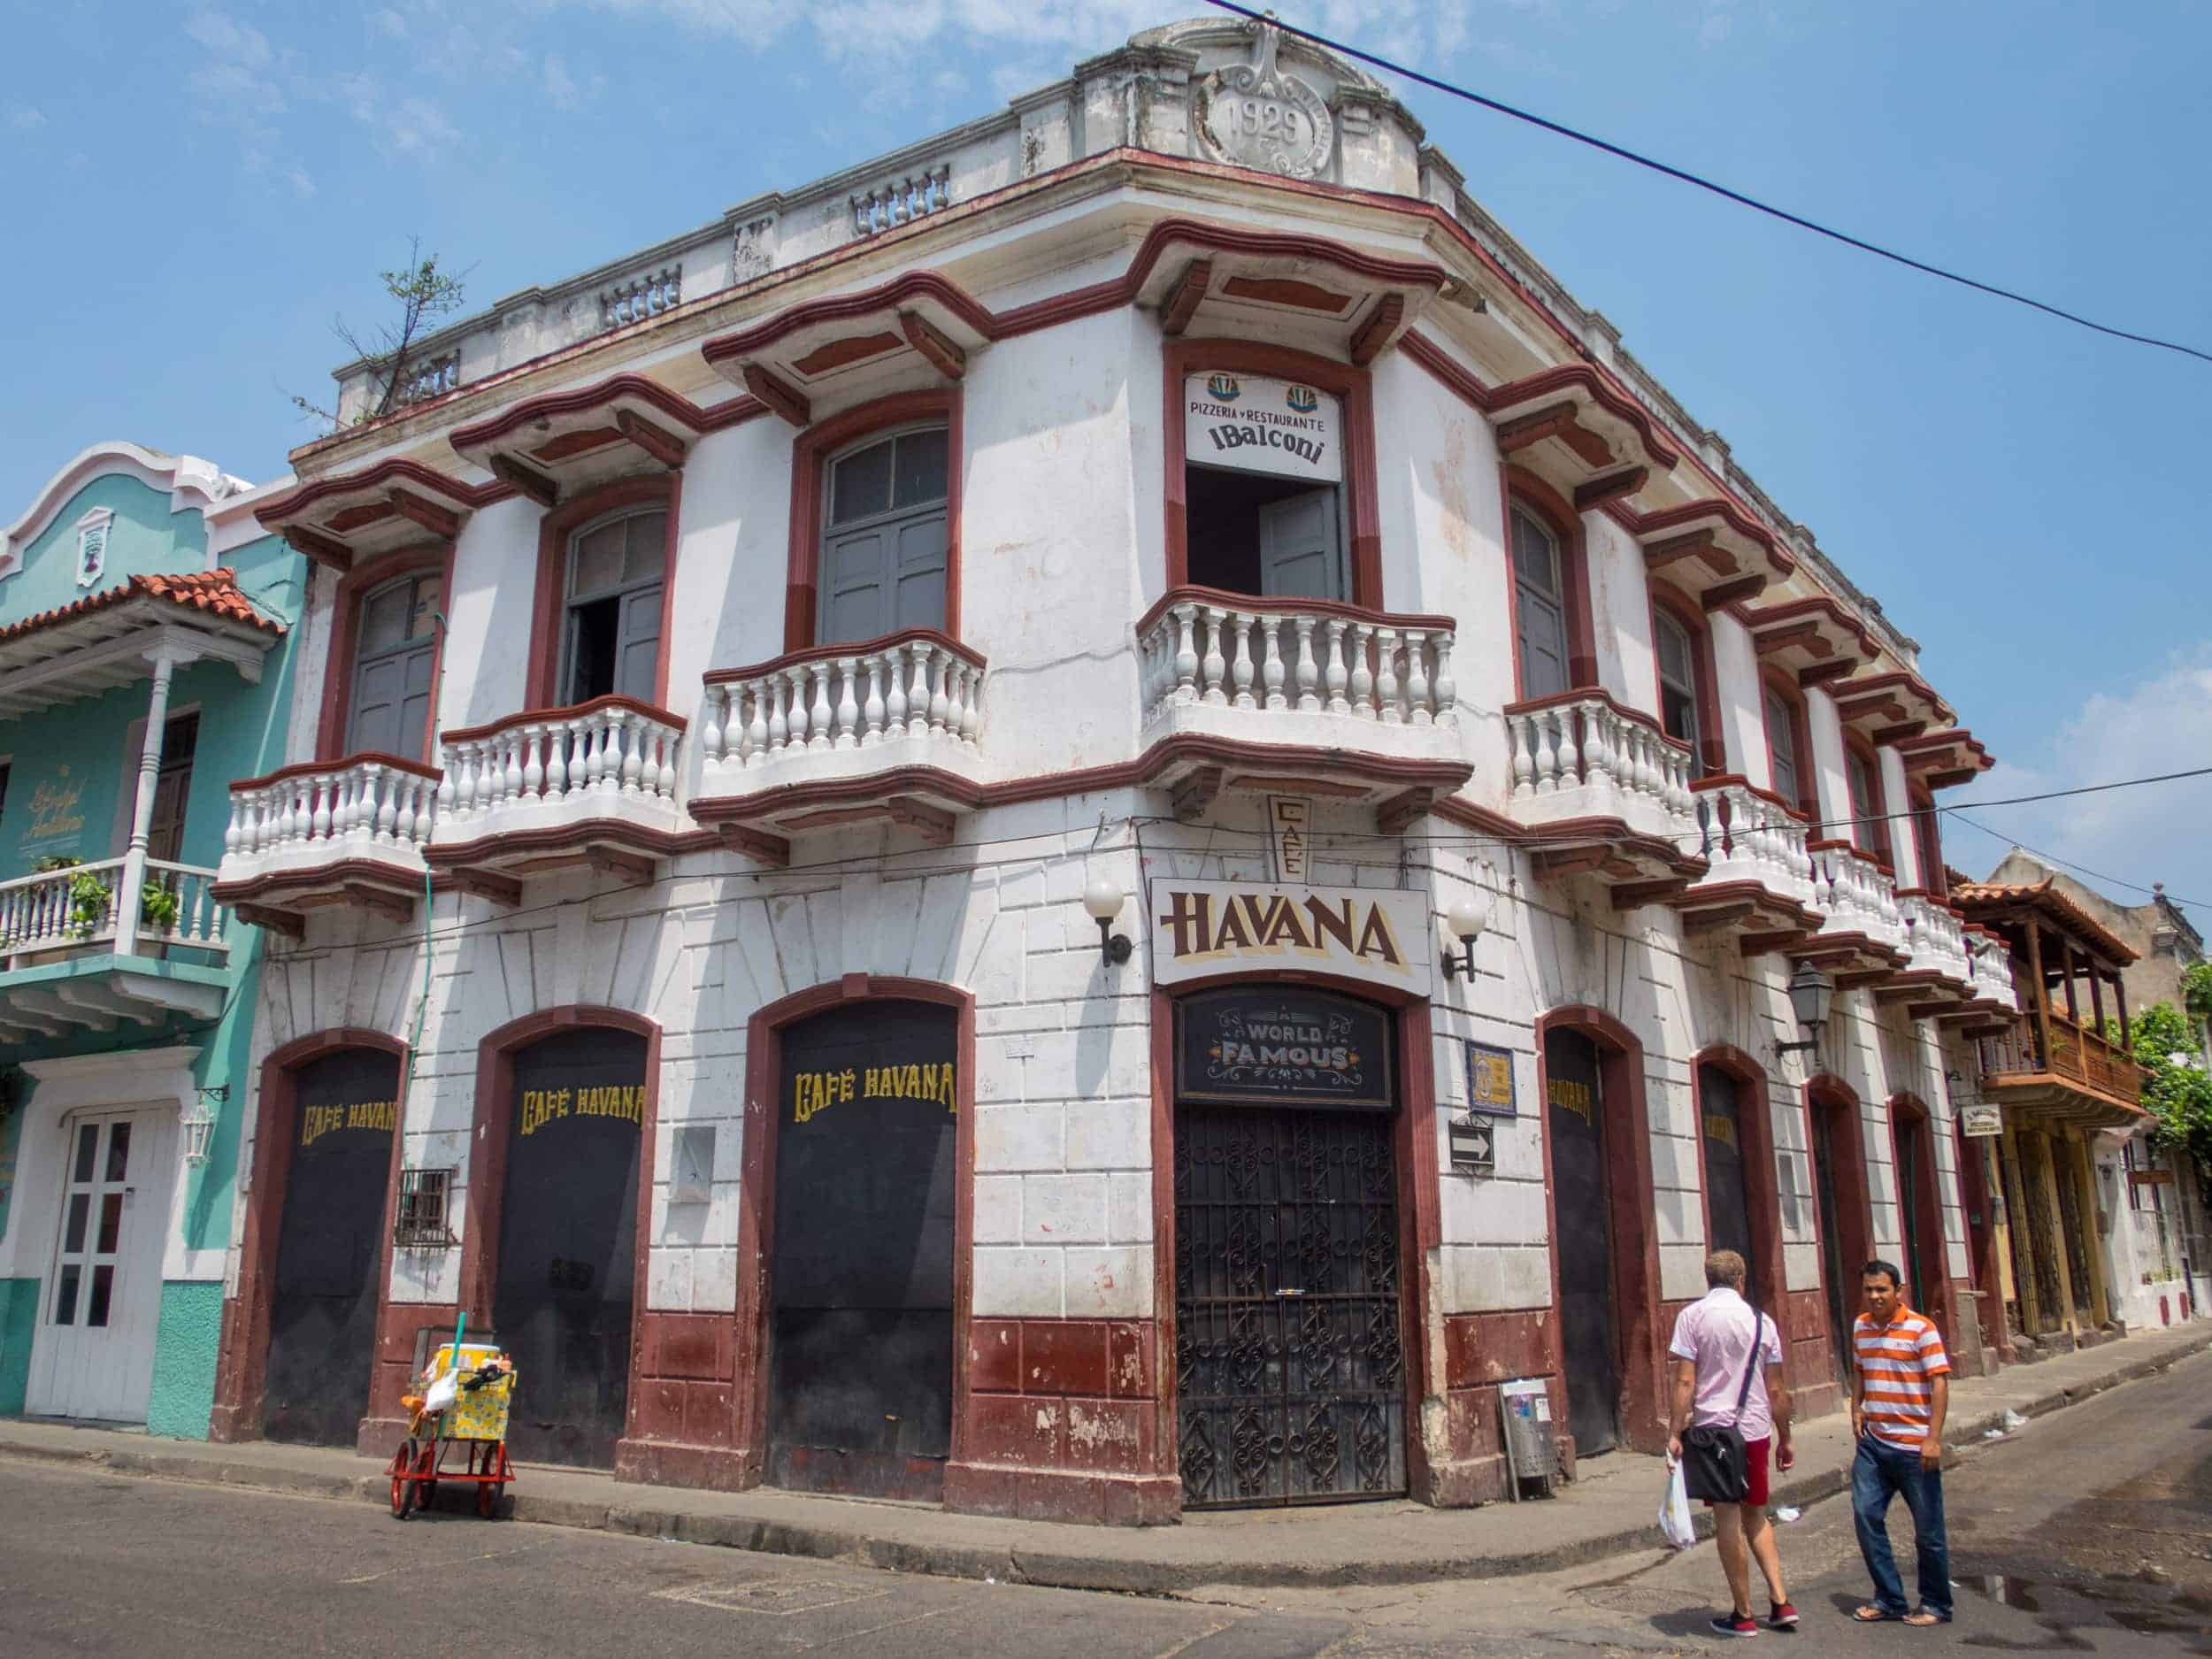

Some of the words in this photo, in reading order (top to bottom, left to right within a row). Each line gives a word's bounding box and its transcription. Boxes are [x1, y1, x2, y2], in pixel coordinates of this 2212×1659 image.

[1229, 101, 1298, 145] 1929
[1190, 401, 1238, 419] PIZZERIA
[1246, 410, 1326, 433] RESTAURANTE
[1160, 891, 1403, 967] HAVANA
[1222, 1040, 1348, 1069] FAMOUS
[1248, 1024, 1324, 1042] WORLD
[520, 1087, 572, 1135] CAFÉ
[794, 1068, 856, 1123] CAFÉ
[863, 1062, 956, 1113] HAVANA
